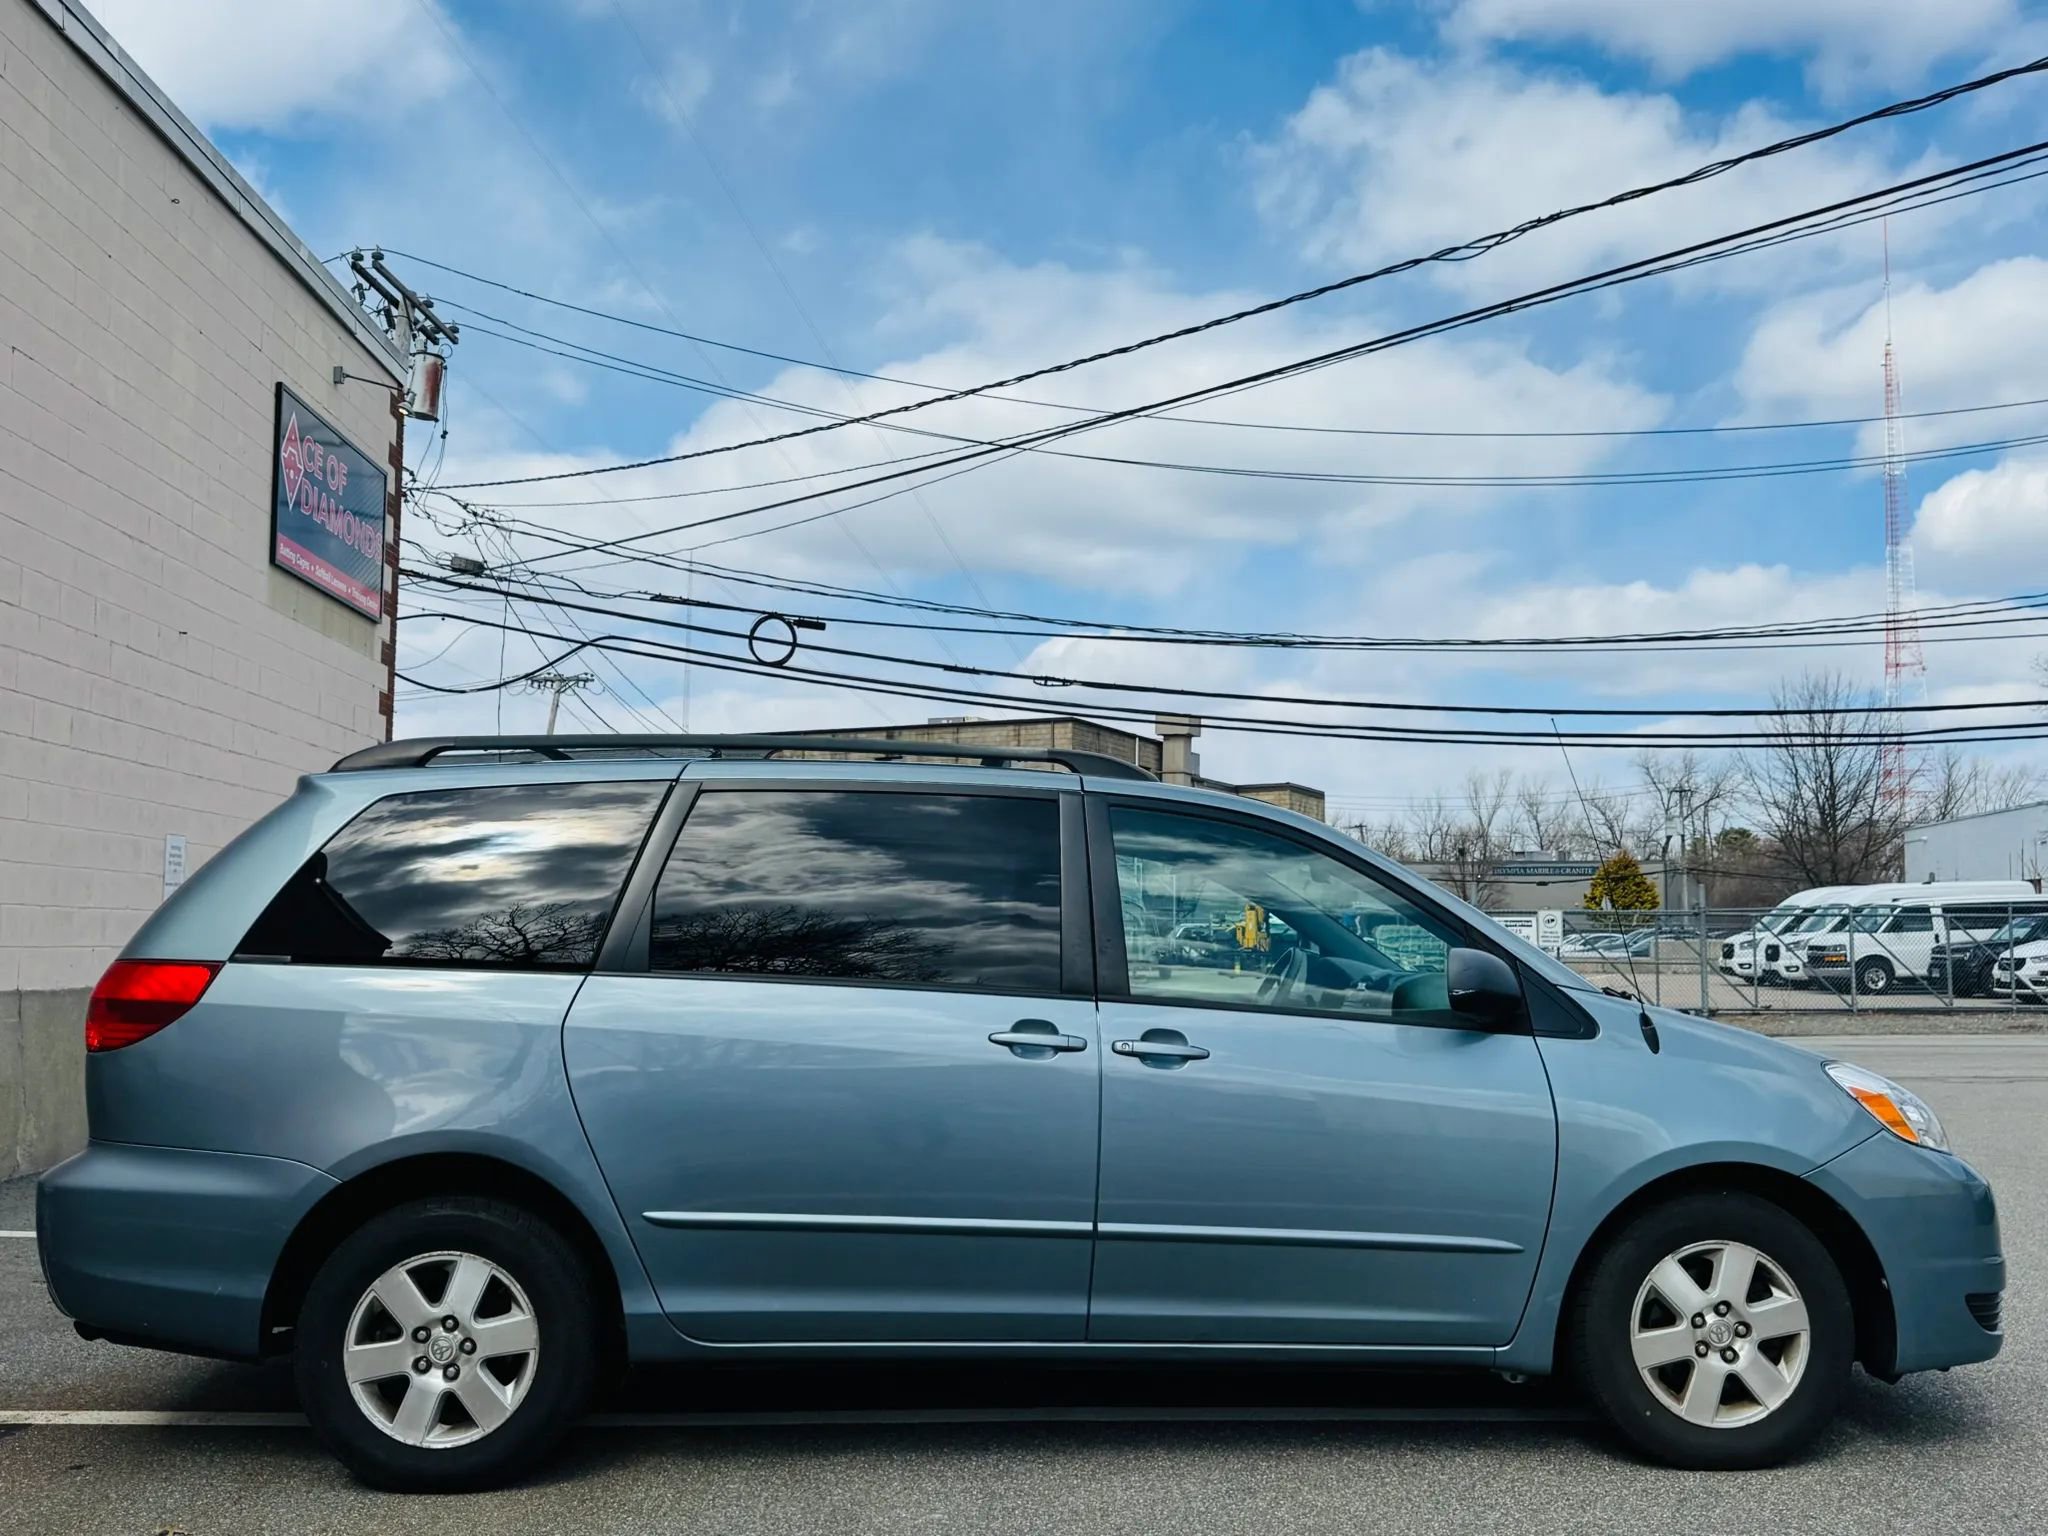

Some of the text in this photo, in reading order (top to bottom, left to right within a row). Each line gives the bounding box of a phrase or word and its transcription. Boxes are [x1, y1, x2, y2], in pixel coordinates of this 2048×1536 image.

[326, 454, 348, 496] OF
[301, 477, 383, 565] DIAMONDS
[1560, 867, 1592, 875] GRANITE
